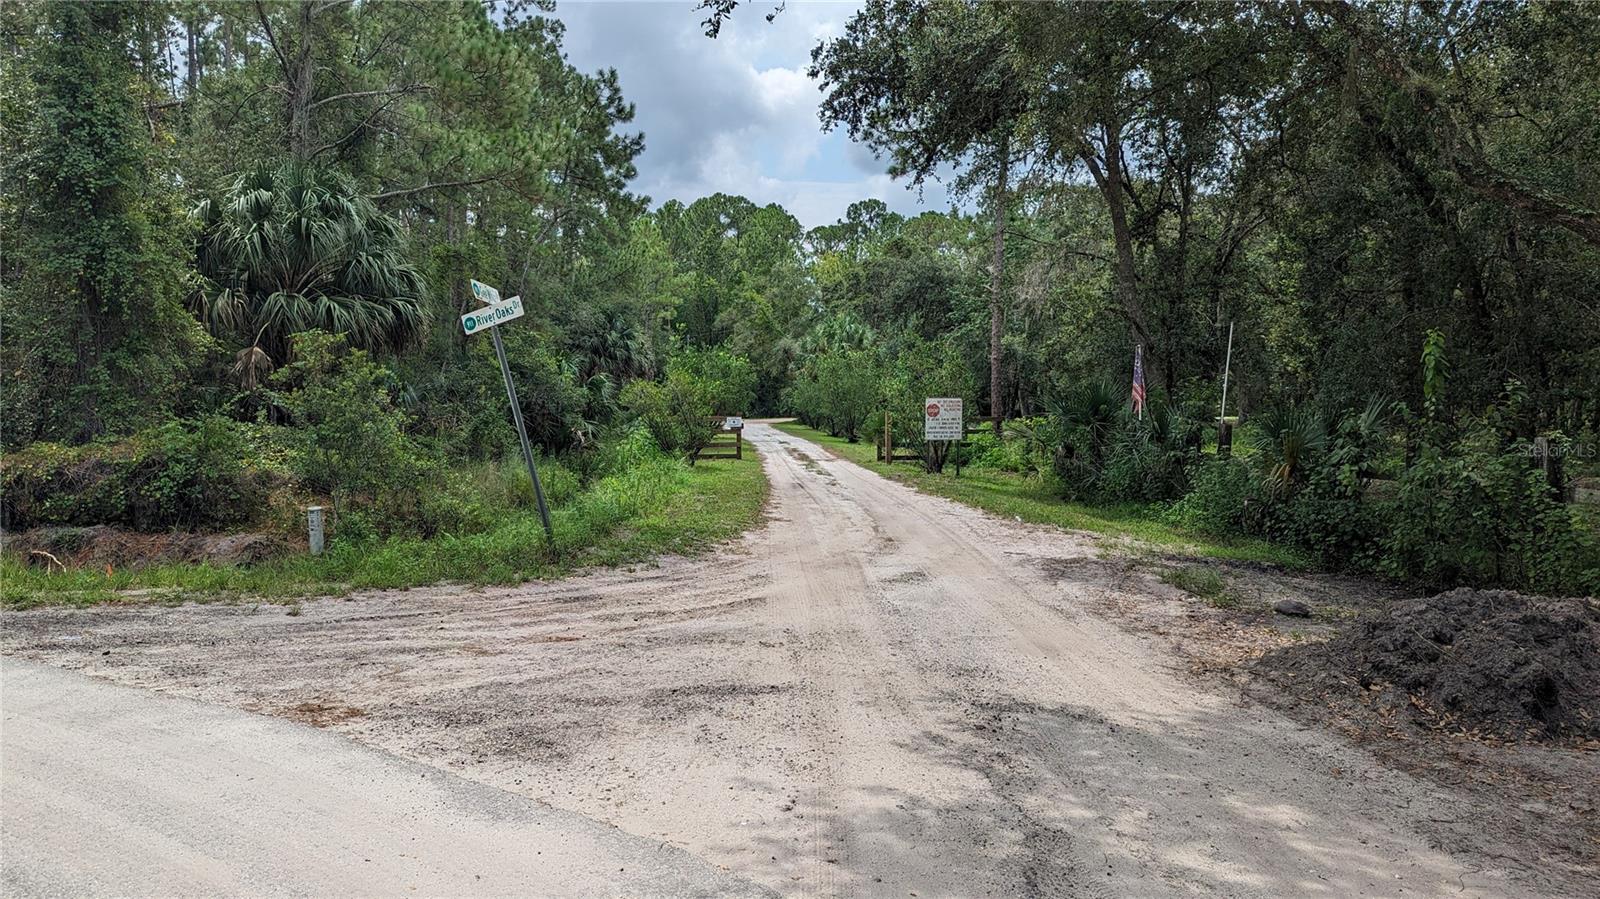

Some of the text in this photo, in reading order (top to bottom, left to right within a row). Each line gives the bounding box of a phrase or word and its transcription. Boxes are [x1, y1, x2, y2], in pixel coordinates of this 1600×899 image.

[476, 313, 495, 326] River
[495, 305, 514, 319] Oaks
[512, 300, 520, 310] Dr
